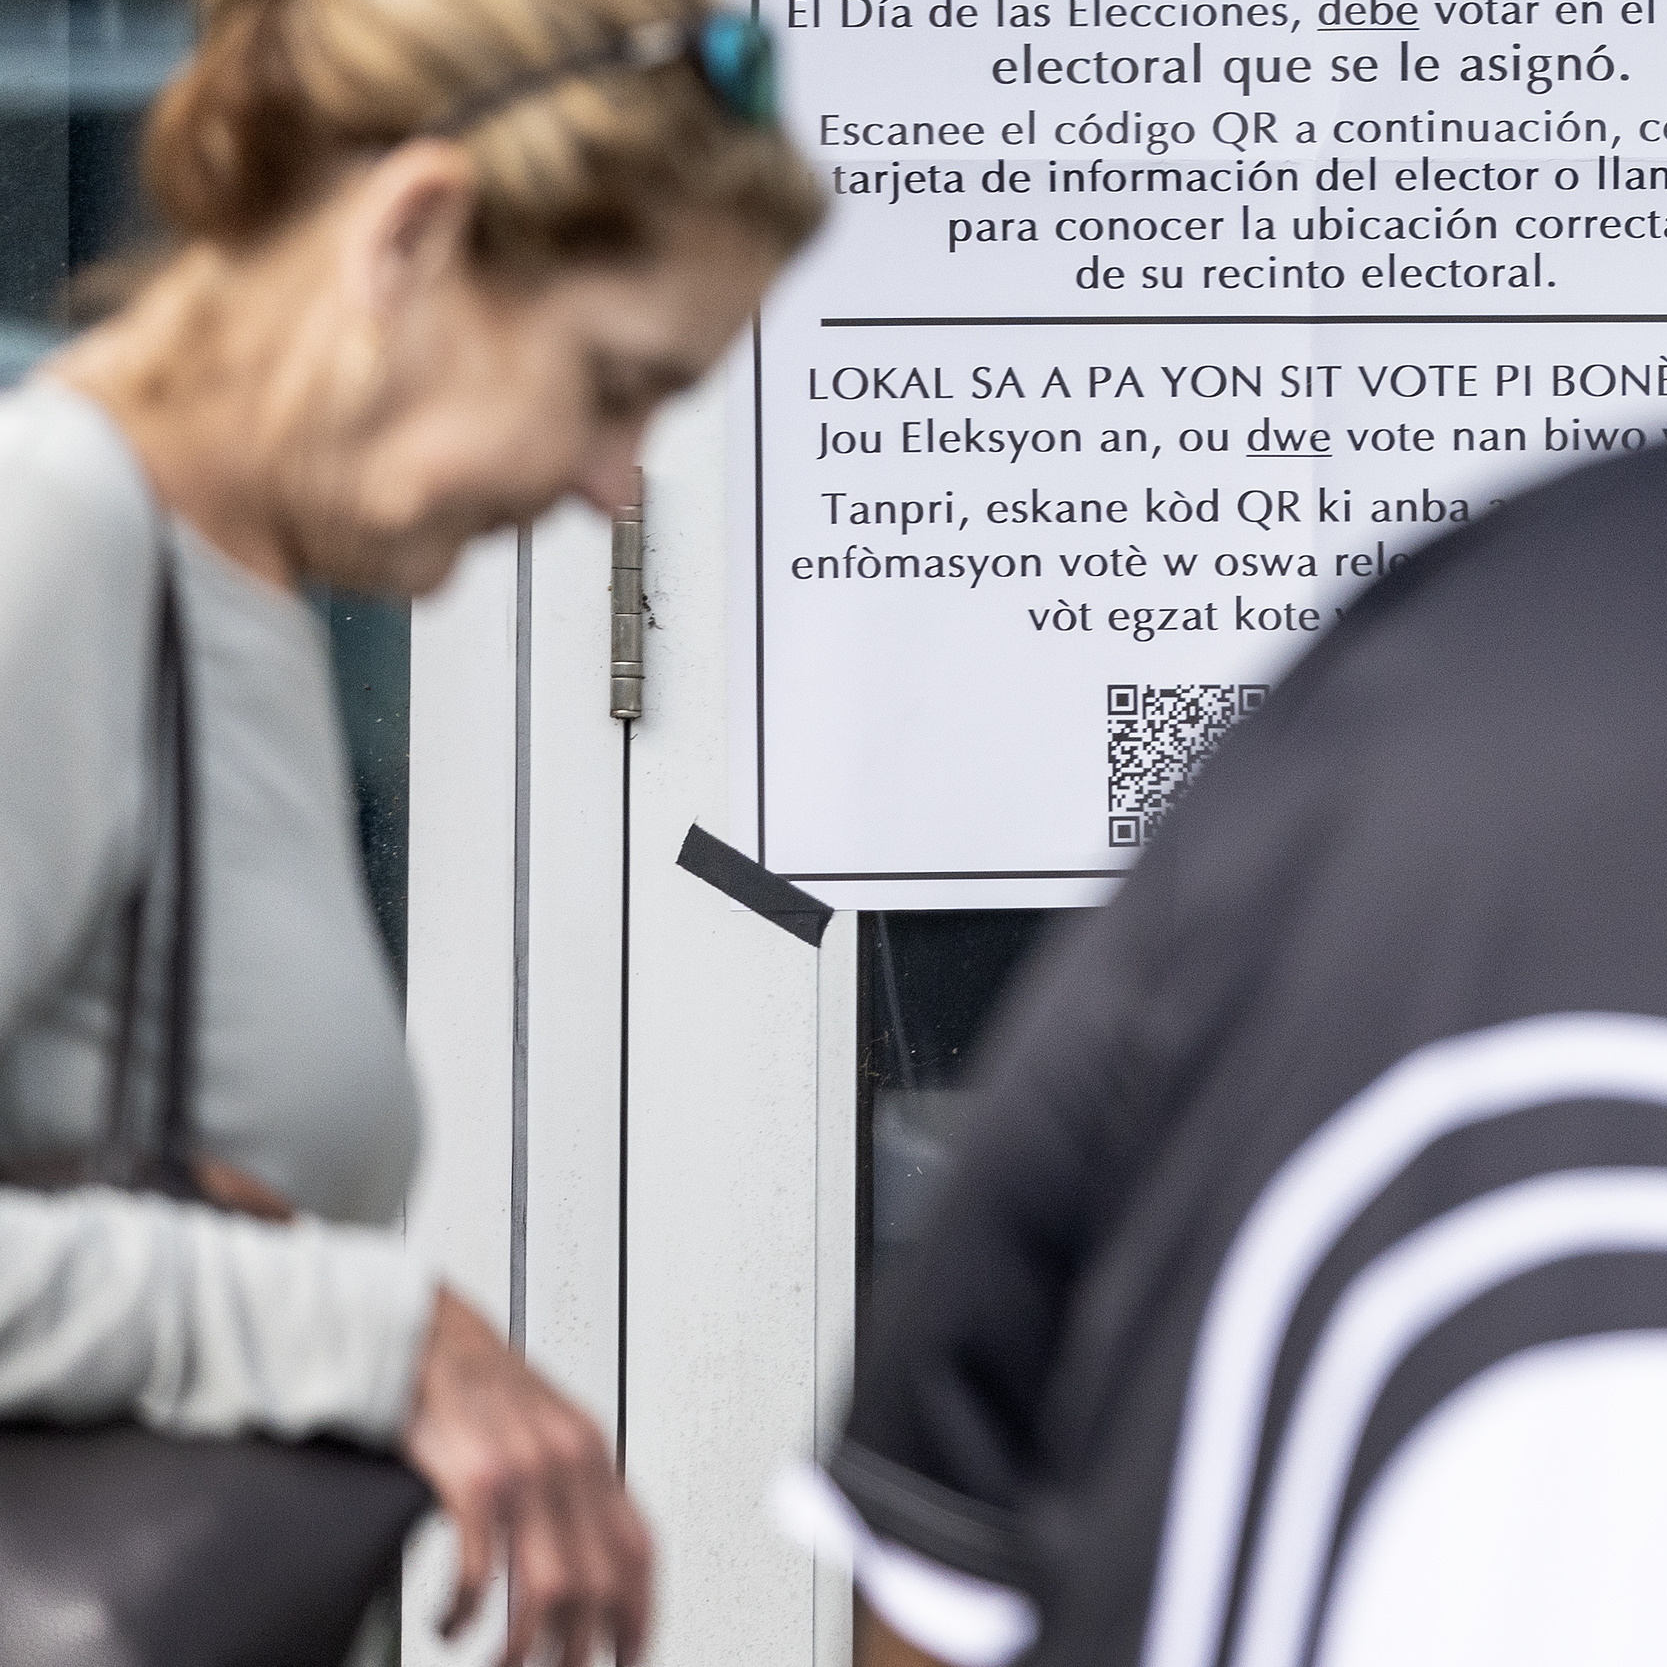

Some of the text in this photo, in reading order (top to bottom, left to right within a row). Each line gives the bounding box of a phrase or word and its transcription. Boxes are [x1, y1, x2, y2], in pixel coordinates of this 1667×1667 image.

[1556, 2, 1602, 24] en
[816, 423, 881, 459] Jou
[903, 418, 1081, 463] Eleksyon
[1101, 429, 1161, 459] an,
[1179, 429, 1228, 451] ou
[1248, 417, 1330, 452] dwe
[1347, 424, 1434, 451] vote
[1454, 428, 1525, 451] nan
[1546, 417, 1647, 451] biwo
[792, 545, 1041, 588] enfòmasyon
[1059, 545, 1147, 577] votè
[1163, 554, 1198, 576] w
[1215, 554, 1318, 577] oswa
[1028, 599, 1092, 631] vòt
[1108, 603, 1218, 642] egzat
[1236, 596, 1320, 631] kote
